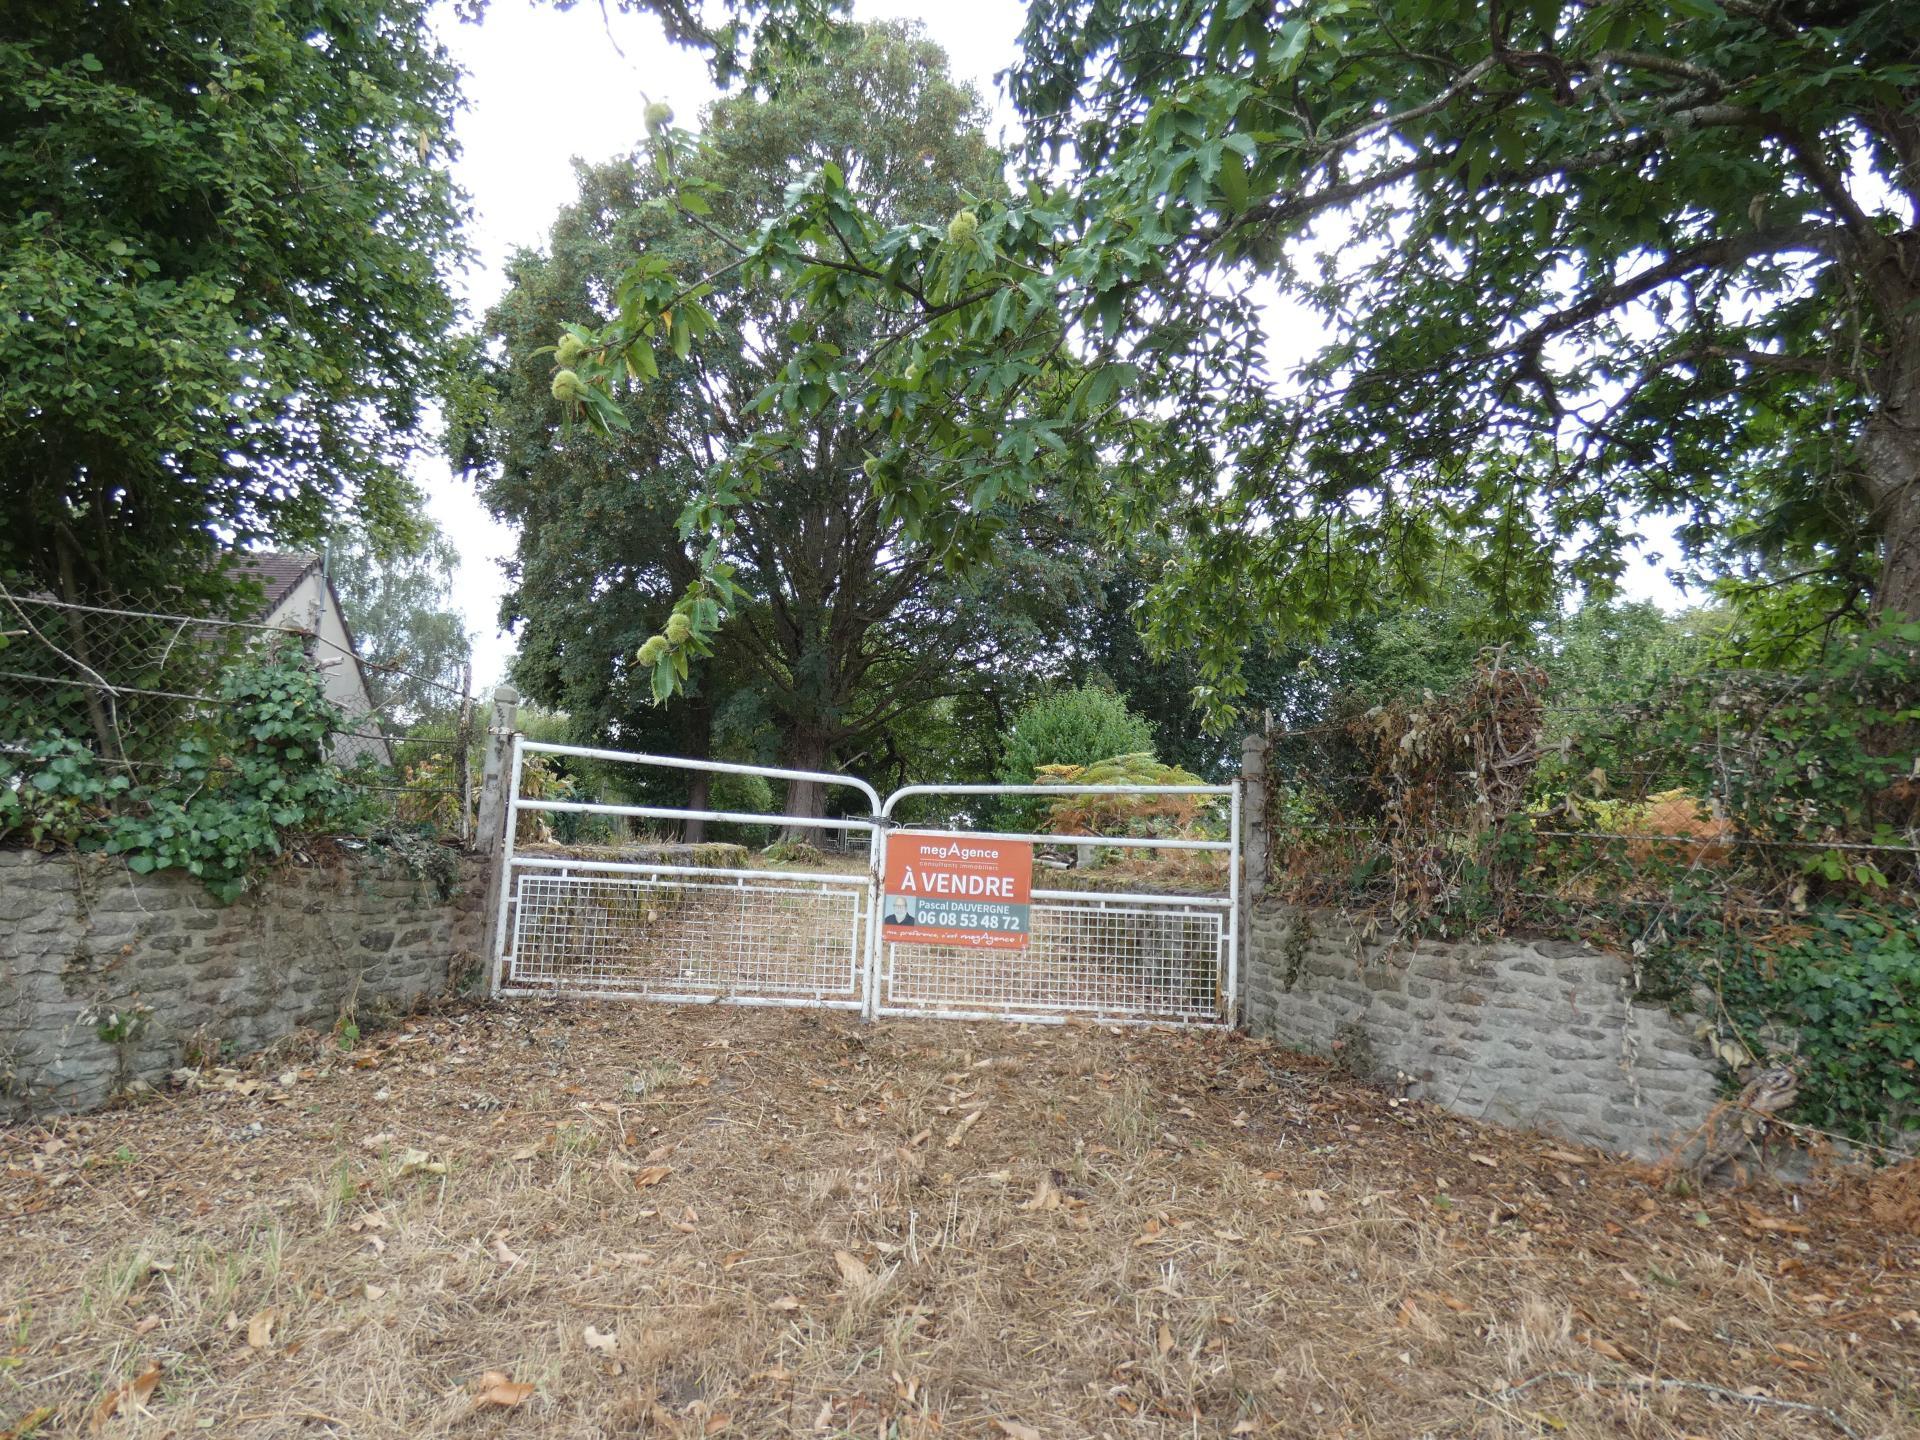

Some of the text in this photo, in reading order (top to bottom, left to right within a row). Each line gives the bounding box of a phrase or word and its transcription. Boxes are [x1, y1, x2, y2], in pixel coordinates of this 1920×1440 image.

[920, 842, 999, 860] megAgence
[901, 866, 1015, 898] À VENDRE
[918, 900, 1010, 915] Pascal DAUVERGNE
[918, 911, 1020, 930] 06 08 53 48 72
[960, 932, 1016, 945] megAgence
